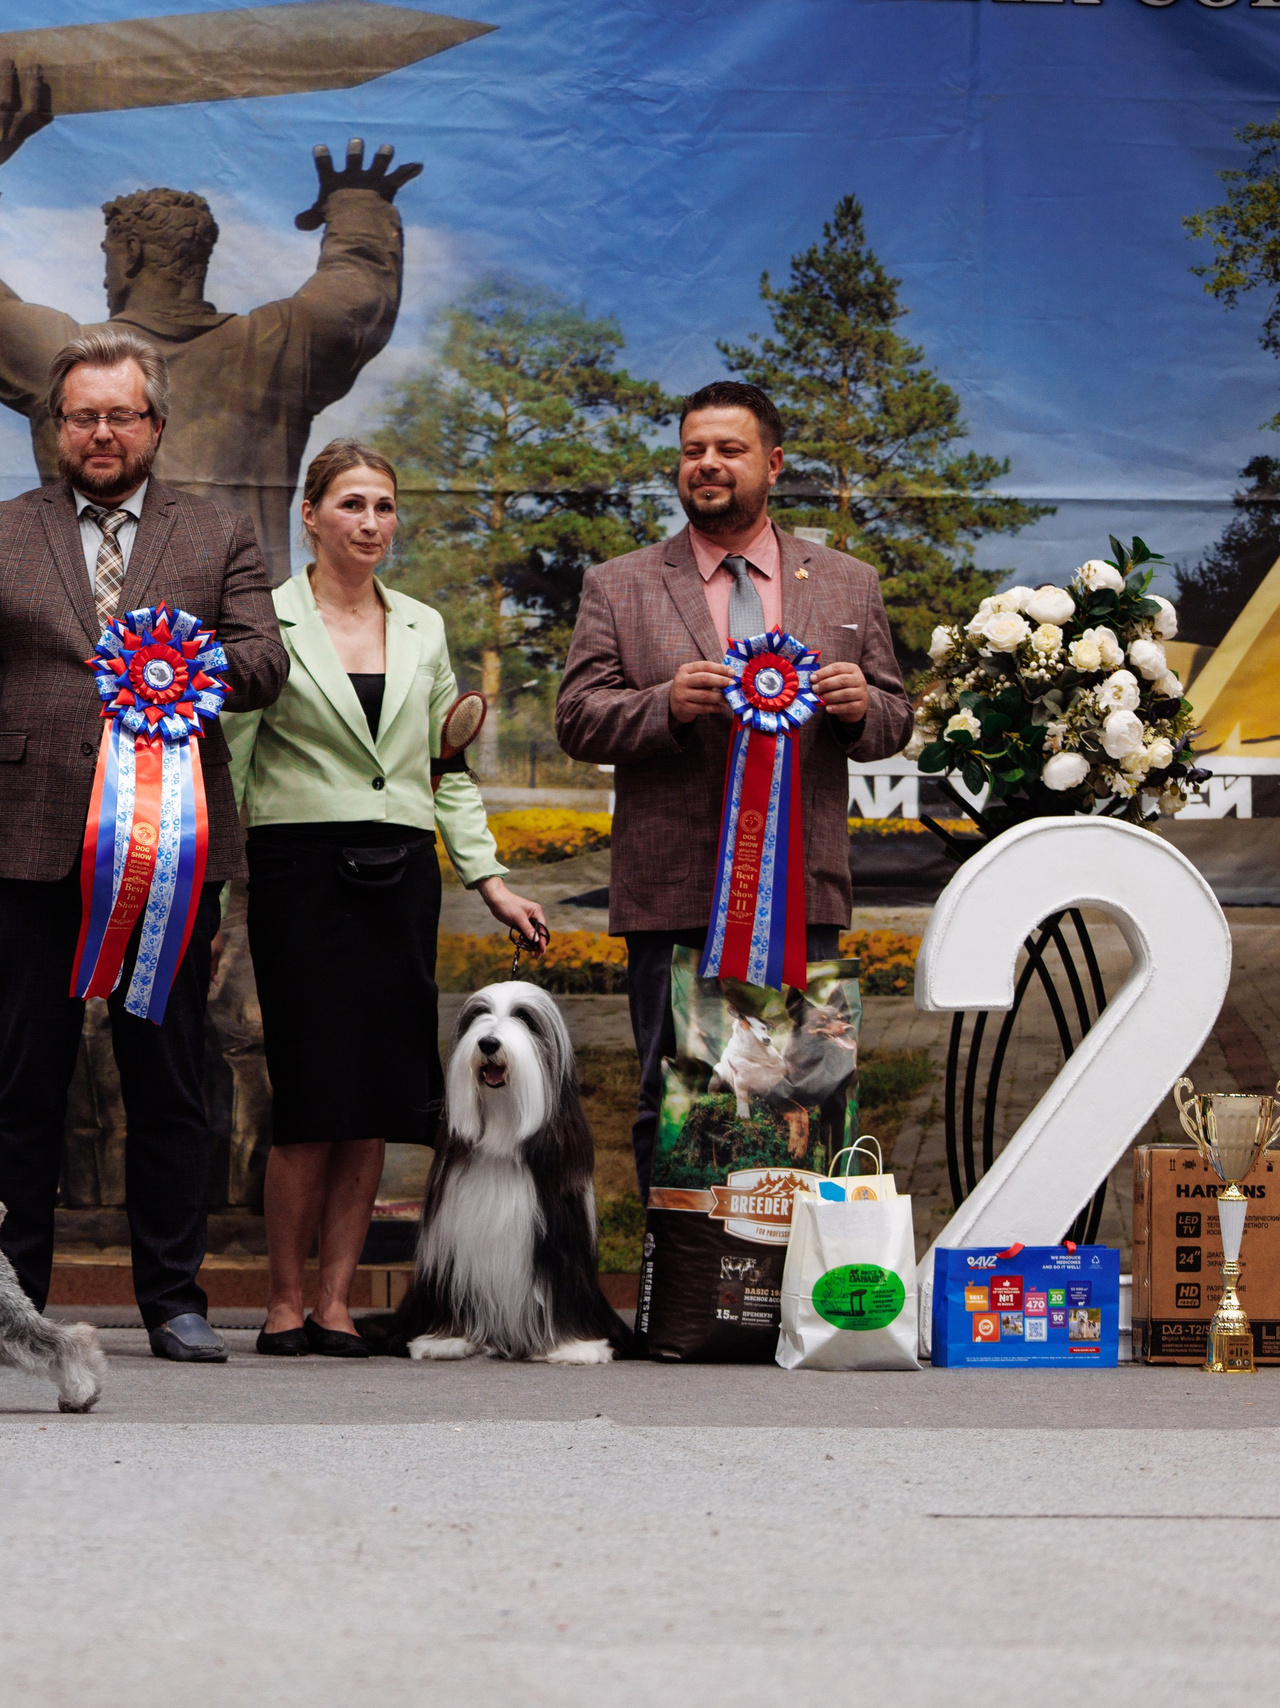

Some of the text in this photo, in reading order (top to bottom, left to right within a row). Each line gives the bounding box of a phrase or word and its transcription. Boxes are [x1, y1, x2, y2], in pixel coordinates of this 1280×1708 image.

[135, 845, 150, 853] DOG
[131, 852, 152, 860] SHOW
[736, 871, 754, 880] Best
[125, 883, 144, 893] Best
[739, 881, 748, 889] In
[127, 893, 136, 901] In
[732, 889, 753, 898] Show
[736, 900, 747, 910] II
[1176, 1184, 1266, 1198] HARTNS
[730, 1195, 792, 1216] BREEDER'
[1179, 1216, 1198, 1224] LED
[756, 1227, 765, 1235] FOR
[1182, 1226, 1196, 1234] TV
[642, 1261, 654, 1310] BREEDER'S
[745, 1287, 769, 1295] BASIC
[1180, 1286, 1198, 1297] HD
[640, 1312, 649, 1334] WAY
